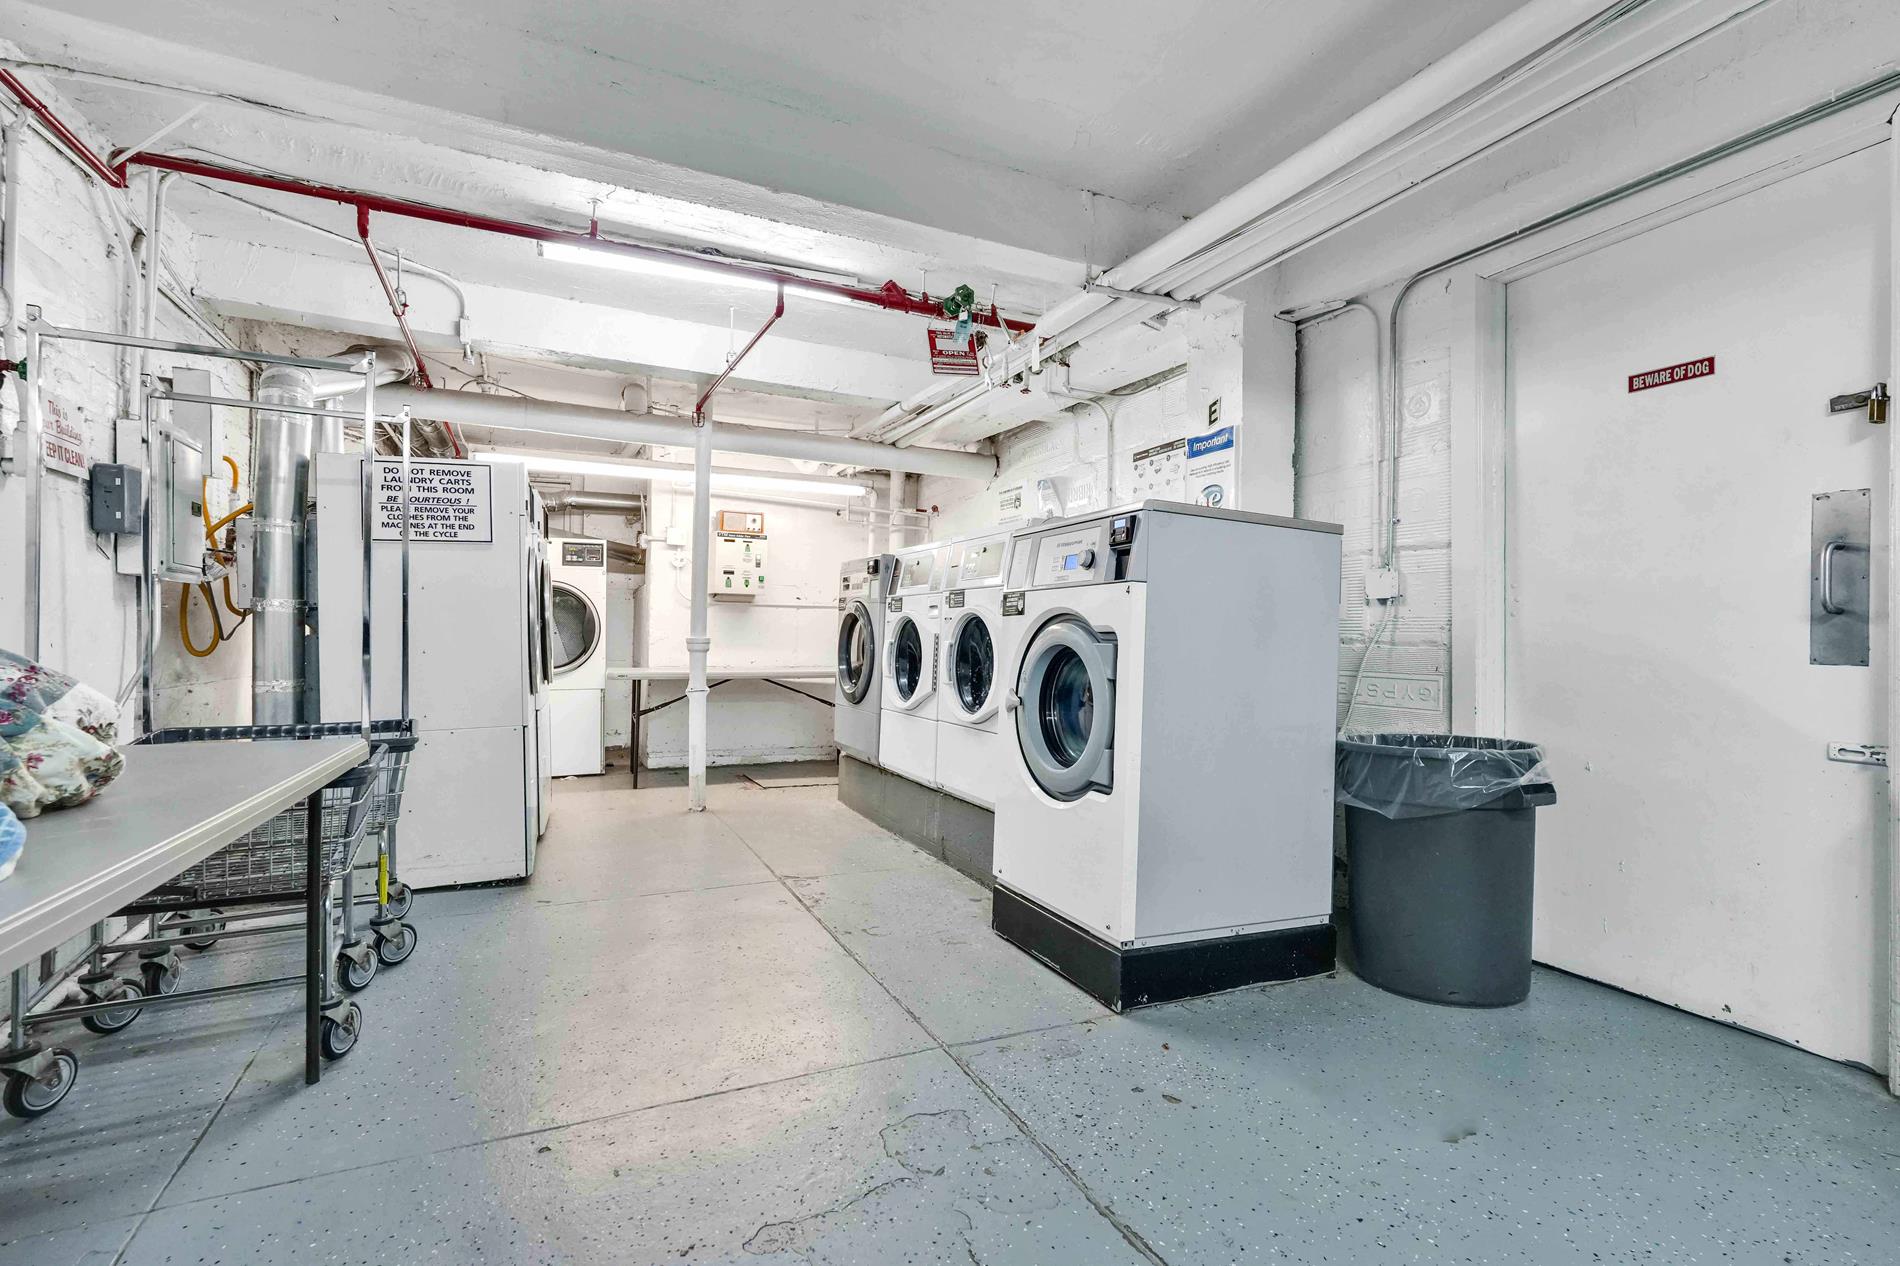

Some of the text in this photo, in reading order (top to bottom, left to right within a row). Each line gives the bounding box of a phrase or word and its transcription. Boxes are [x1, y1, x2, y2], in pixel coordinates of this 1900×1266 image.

[1633, 360, 1710, 390] BEWARE OF DOG
[48, 400, 68, 421] This is
[1208, 399, 1220, 426] E
[1193, 434, 1228, 451] Important
[46, 440, 57, 458] EEP
[407, 468, 426, 476] OT
[429, 469, 472, 478] REMOVE
[439, 478, 472, 486] CARTS
[416, 485, 438, 494] THIS
[442, 487, 475, 495] ROOM
[406, 496, 462, 505] OURTEOUS
[381, 505, 411, 513] PLEA
[387, 513, 469, 523] CLOHES FROM THE
[381, 522, 425, 530] MACNES
[414, 530, 430, 538] THE
